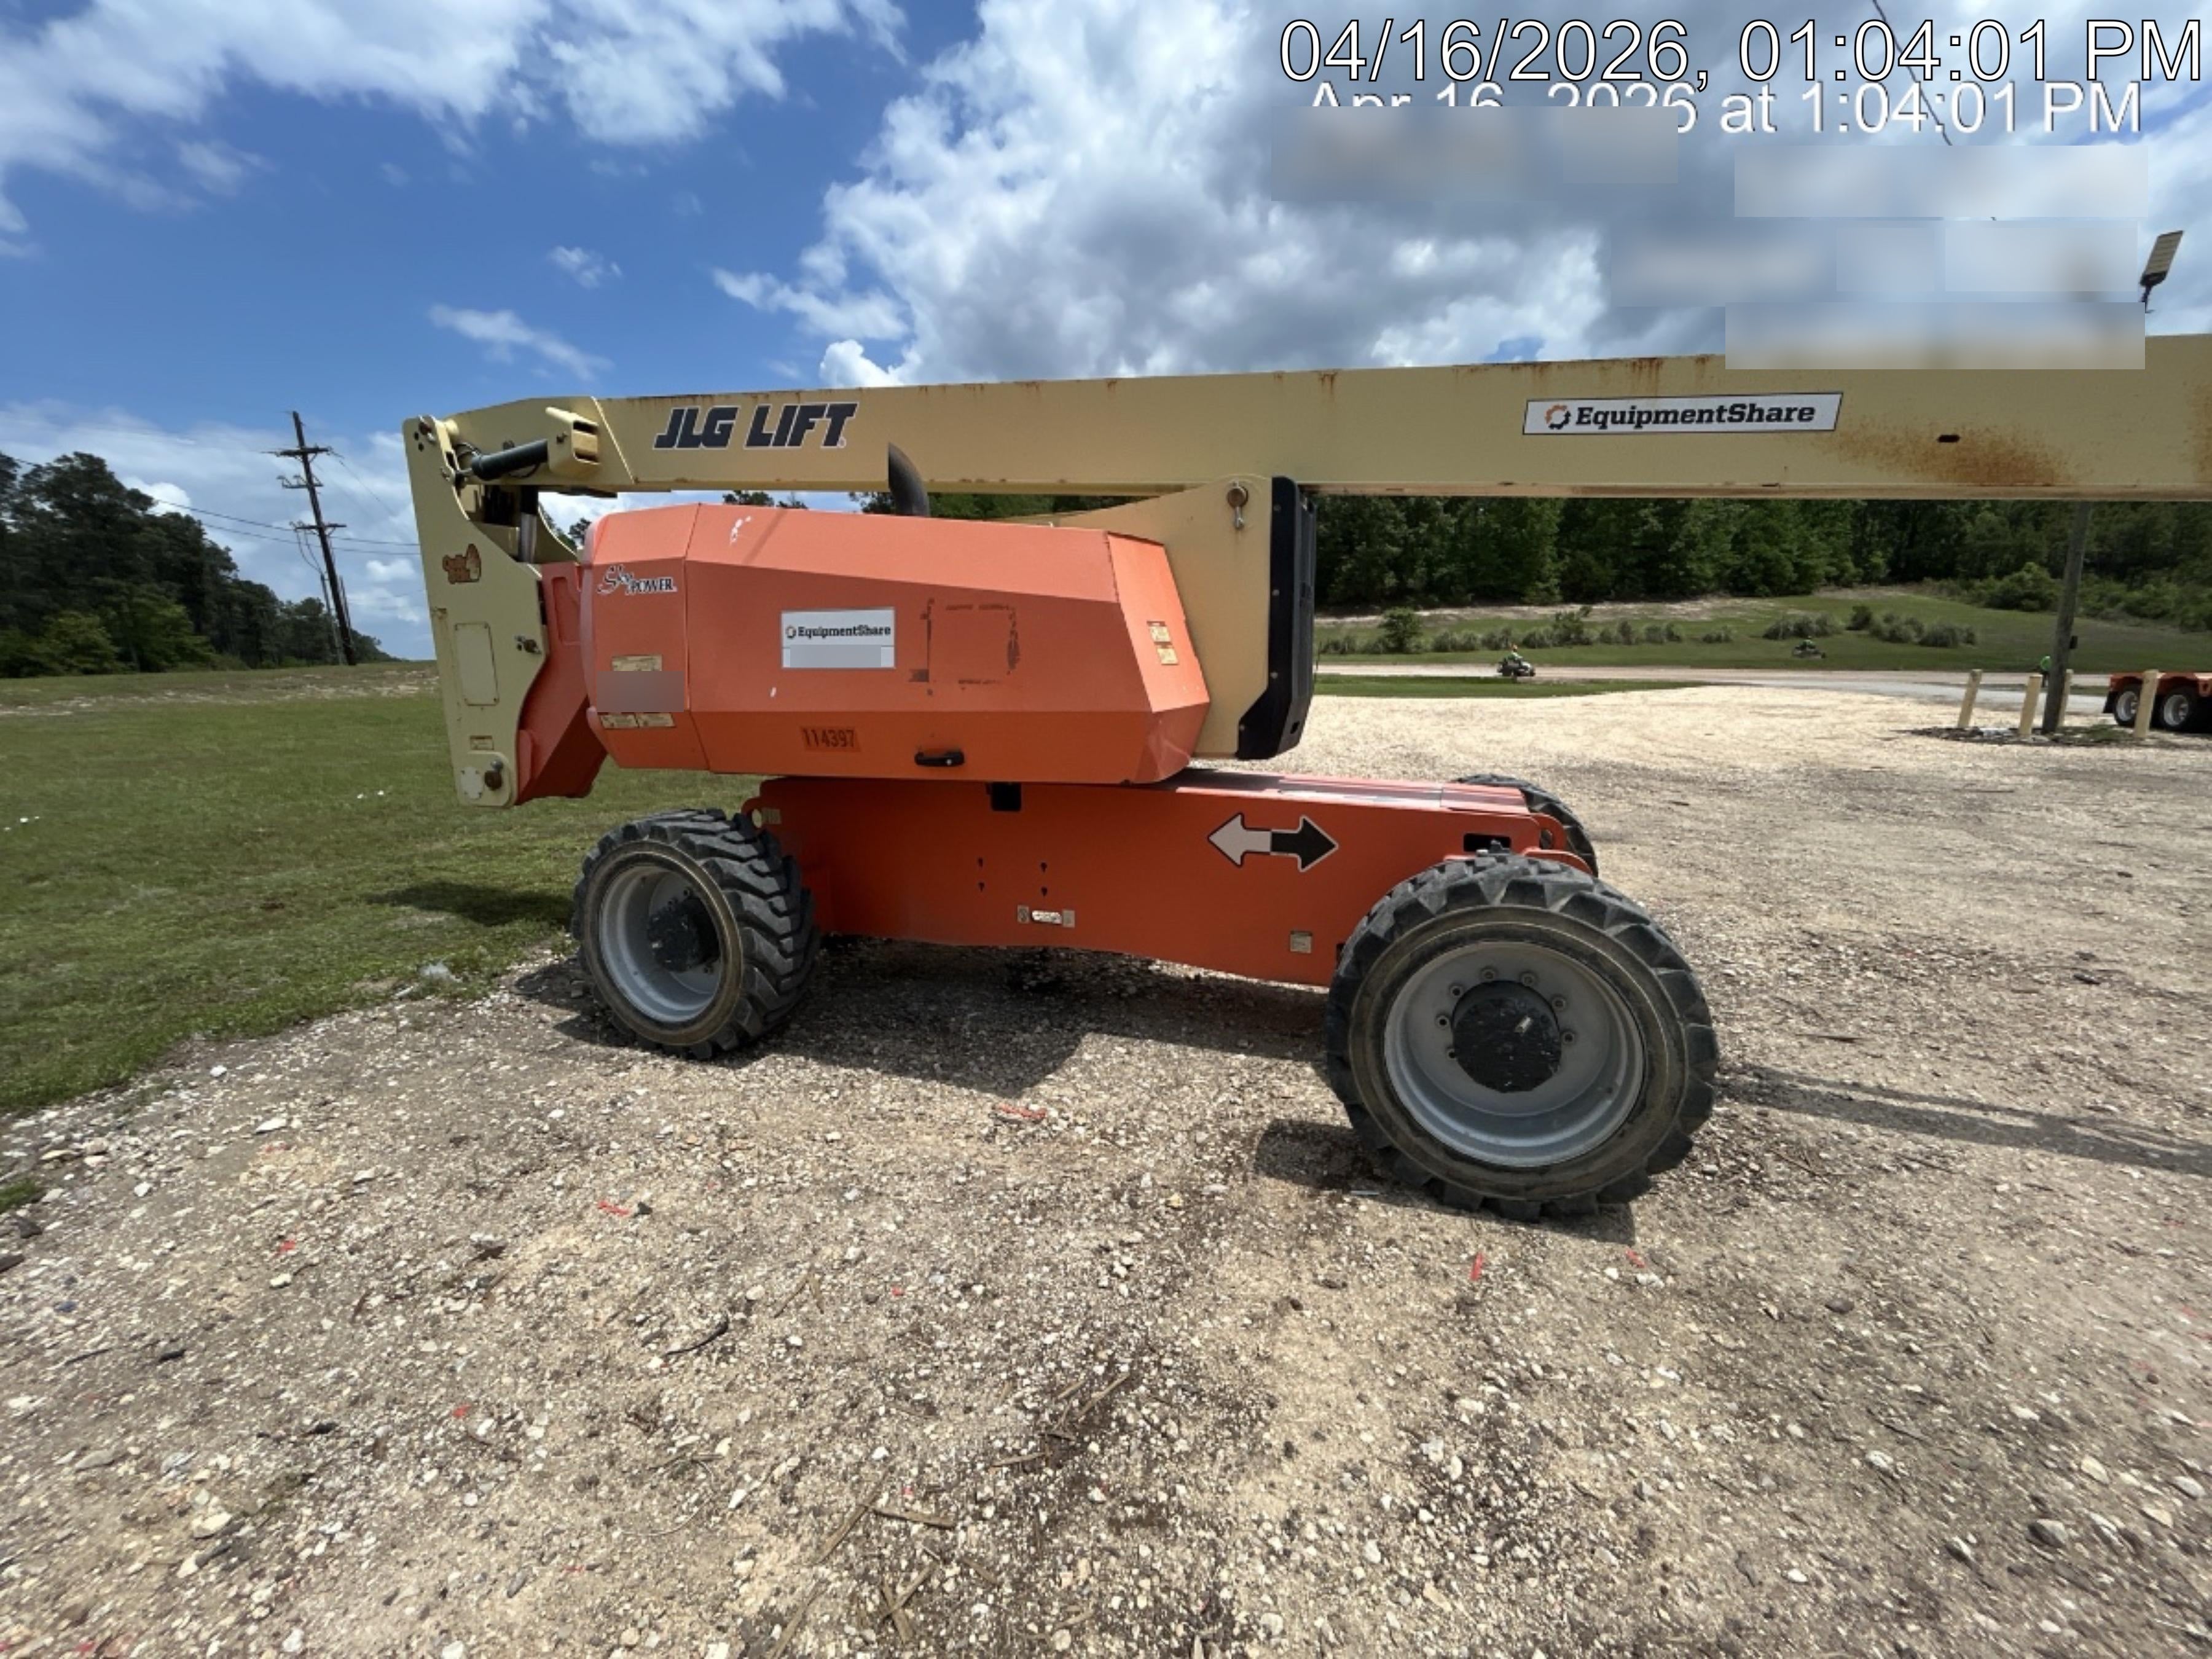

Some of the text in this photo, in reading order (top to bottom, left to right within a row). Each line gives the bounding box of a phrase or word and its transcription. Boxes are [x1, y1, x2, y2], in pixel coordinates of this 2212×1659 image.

[1575, 403, 1816, 429] EquipmentShare
[653, 406, 740, 450] JLG
[798, 625, 892, 640] EquipmentShare
[802, 728, 855, 748] 114397
